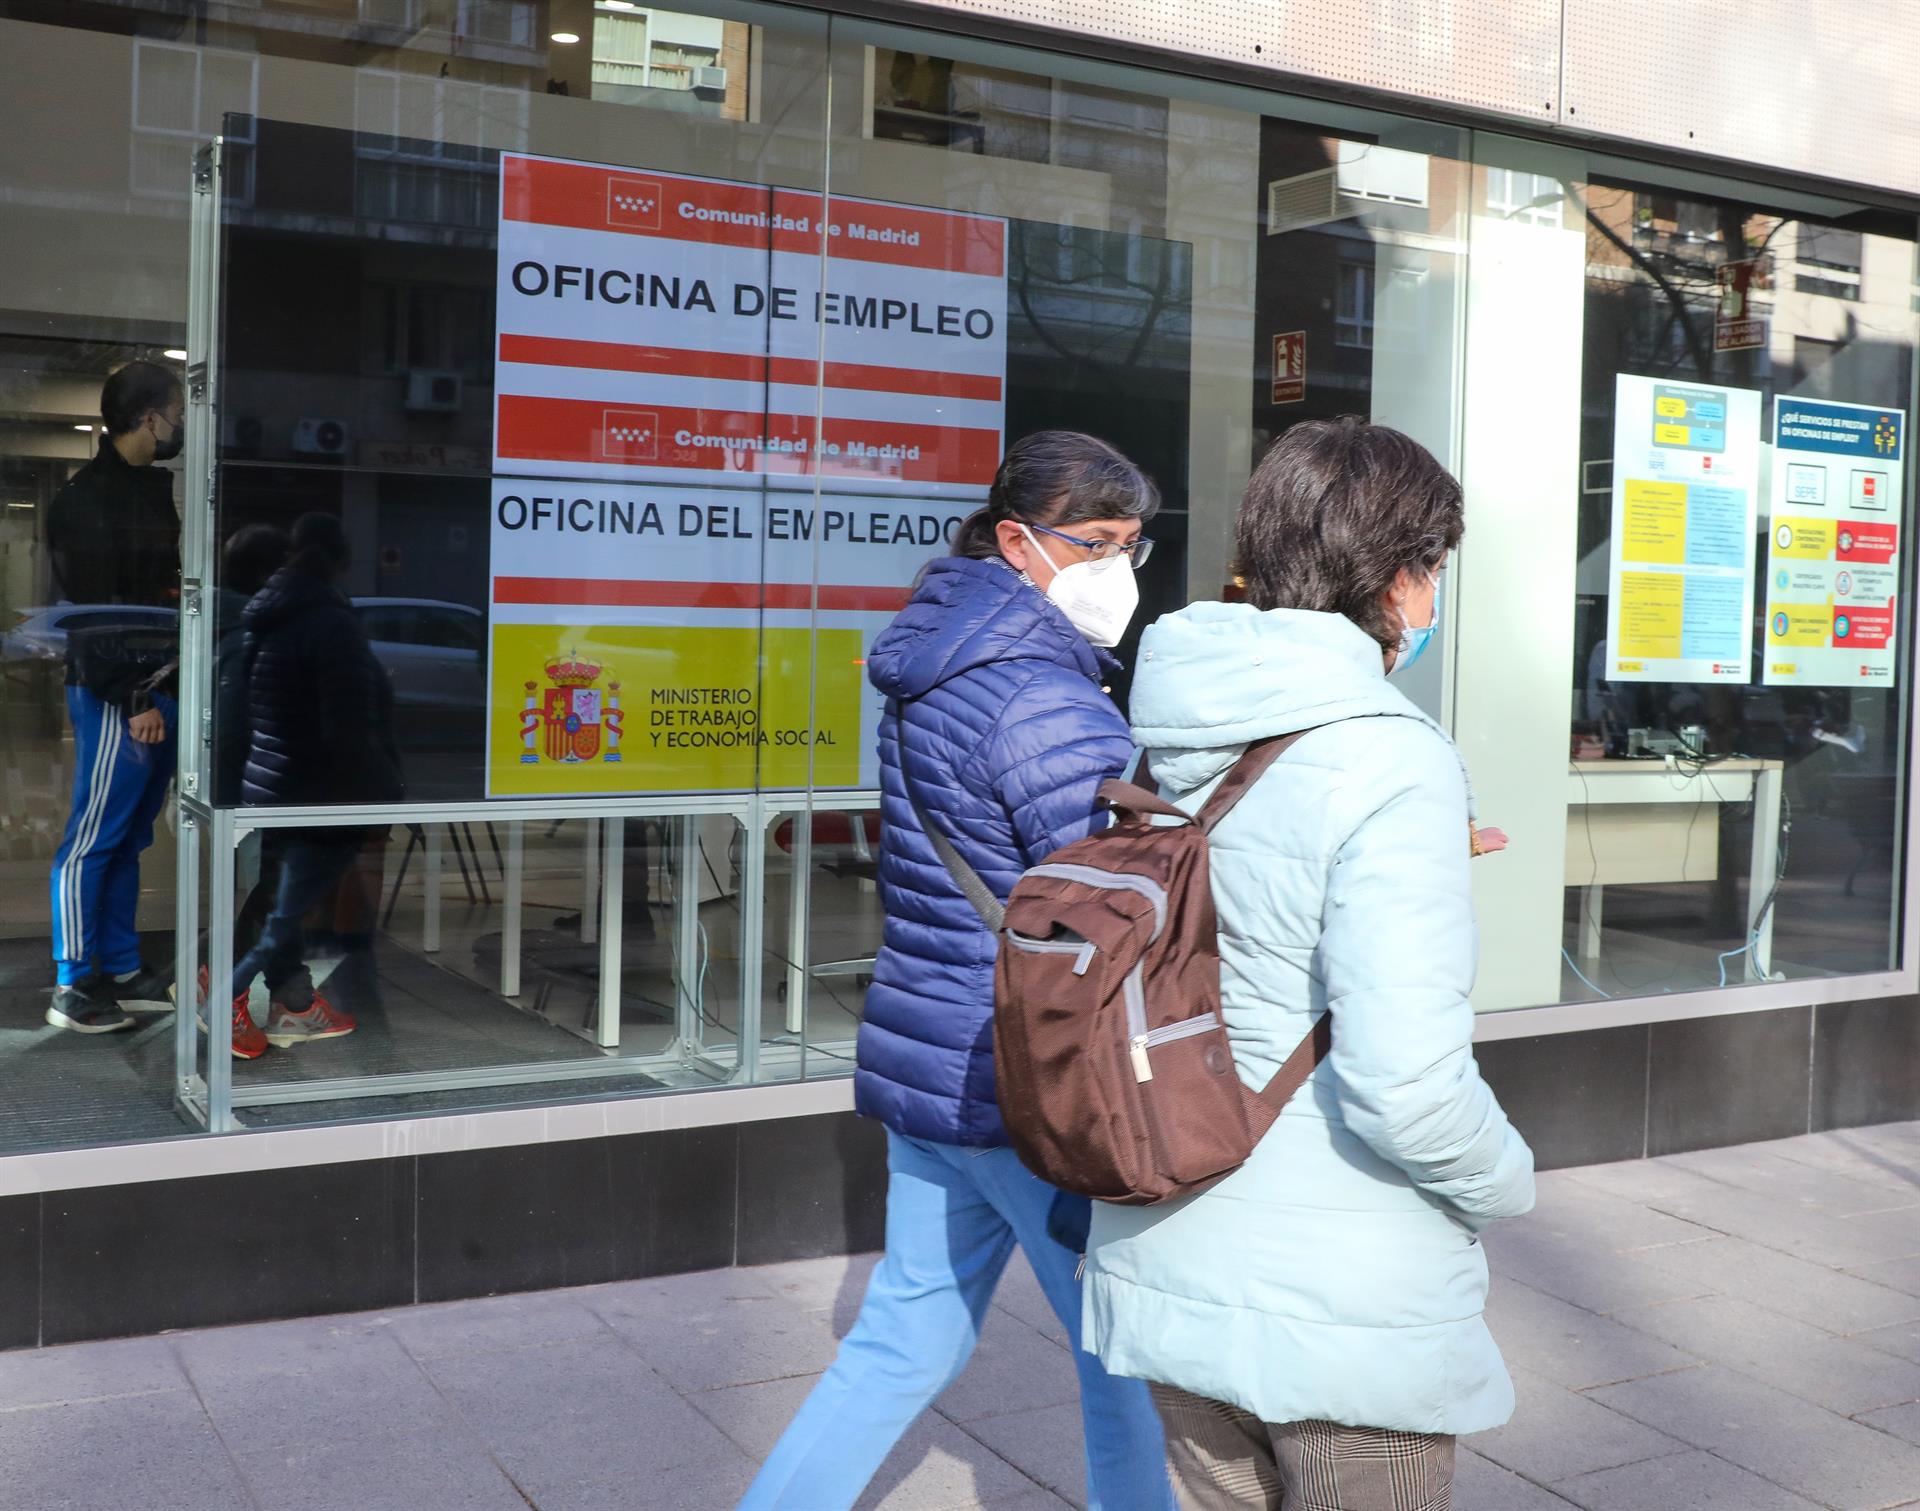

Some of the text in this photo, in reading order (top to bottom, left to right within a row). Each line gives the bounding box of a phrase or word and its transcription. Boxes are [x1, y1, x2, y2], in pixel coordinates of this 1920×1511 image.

[677, 202, 808, 232] Comunidad
[848, 222, 920, 246] Madrid
[511, 260, 994, 340] OFICINA DE EMPLEO
[674, 430, 808, 454] Comunidad
[847, 437, 920, 461] Madrid
[1795, 486, 1817, 499] SEPE
[497, 495, 963, 546] OFICINA DEL EMPLEADO
[650, 688, 752, 706] MINISTERIO
[650, 709, 757, 731] DE TRABAJO
[650, 729, 837, 748] Y ECONOMÍA SOCAL
